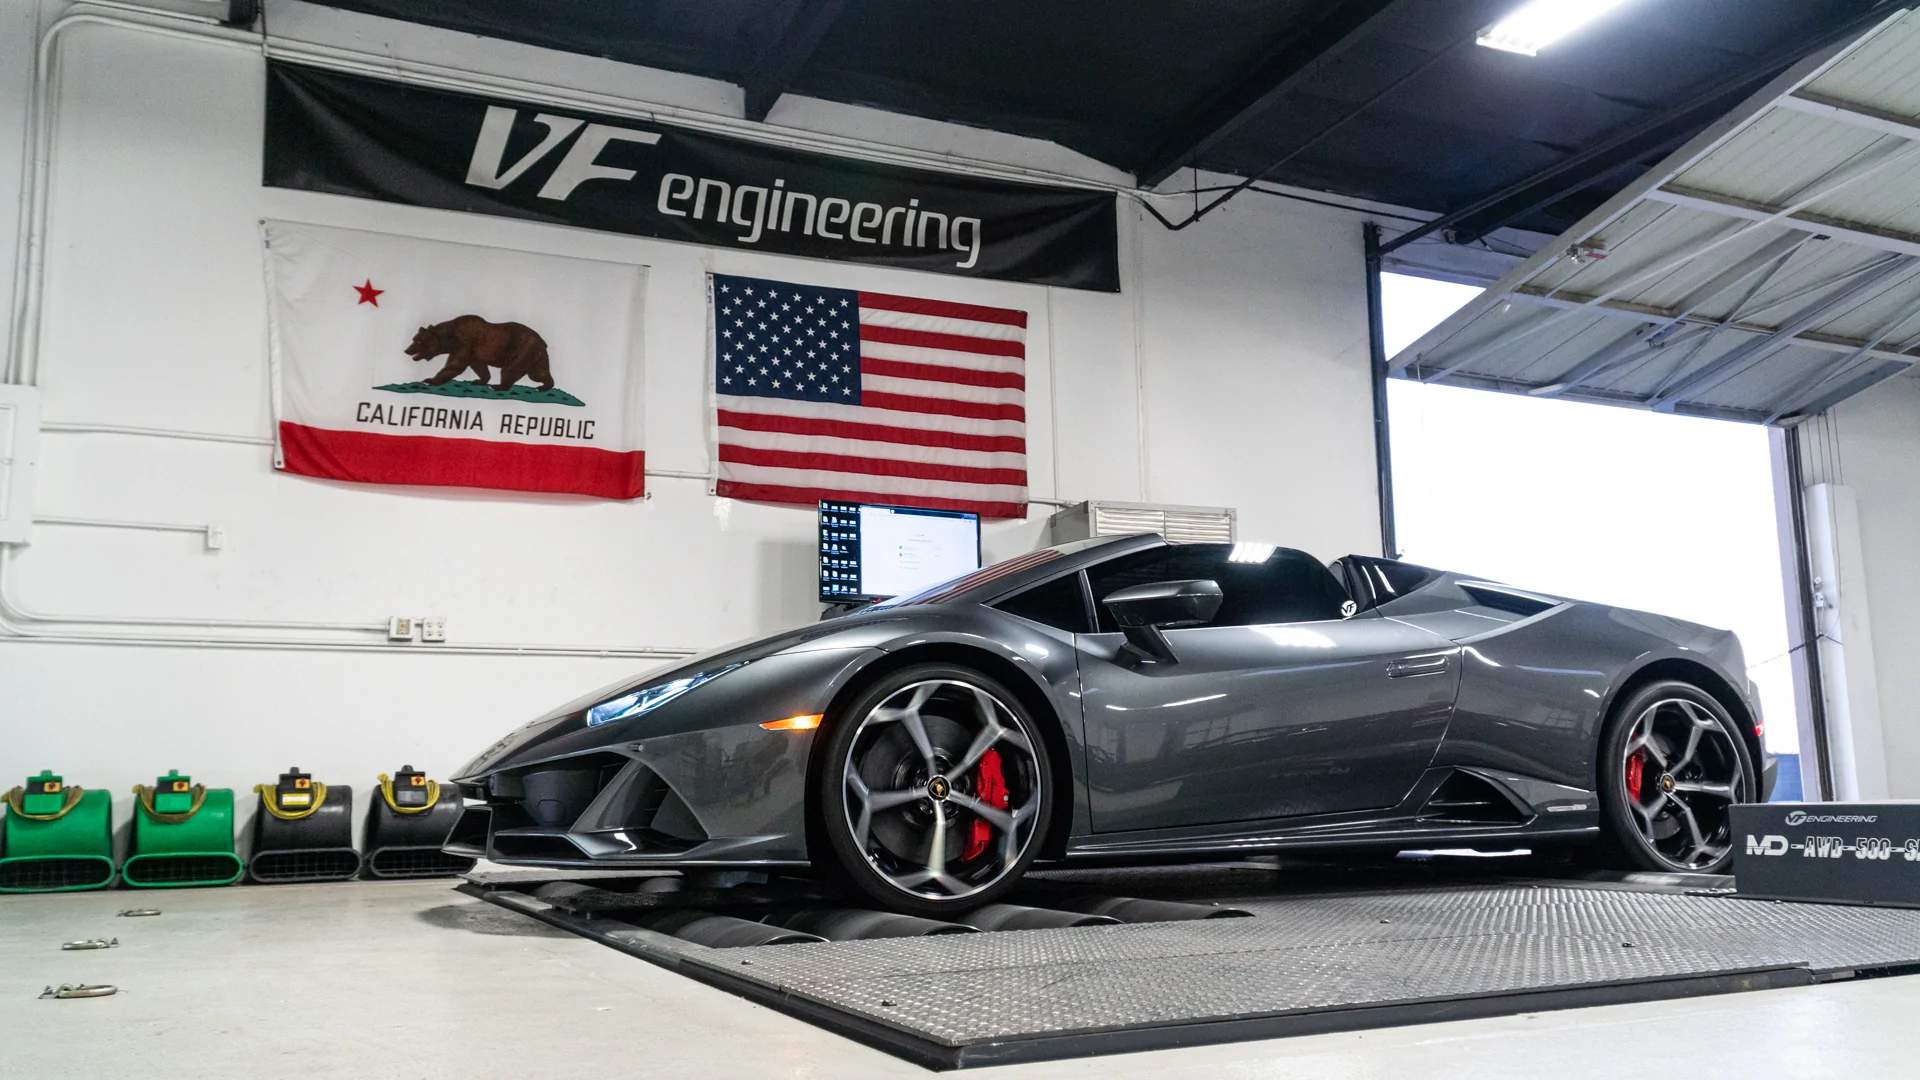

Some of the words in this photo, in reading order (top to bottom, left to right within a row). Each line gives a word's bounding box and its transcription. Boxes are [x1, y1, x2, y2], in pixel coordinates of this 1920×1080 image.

[465, 104, 662, 201] VF
[657, 171, 982, 269] engineering
[355, 401, 484, 432] CALIFORNIA
[499, 413, 596, 440] REPUBLIC
[1341, 601, 1357, 616] VF
[1806, 815, 1878, 823] ENGINEERING
